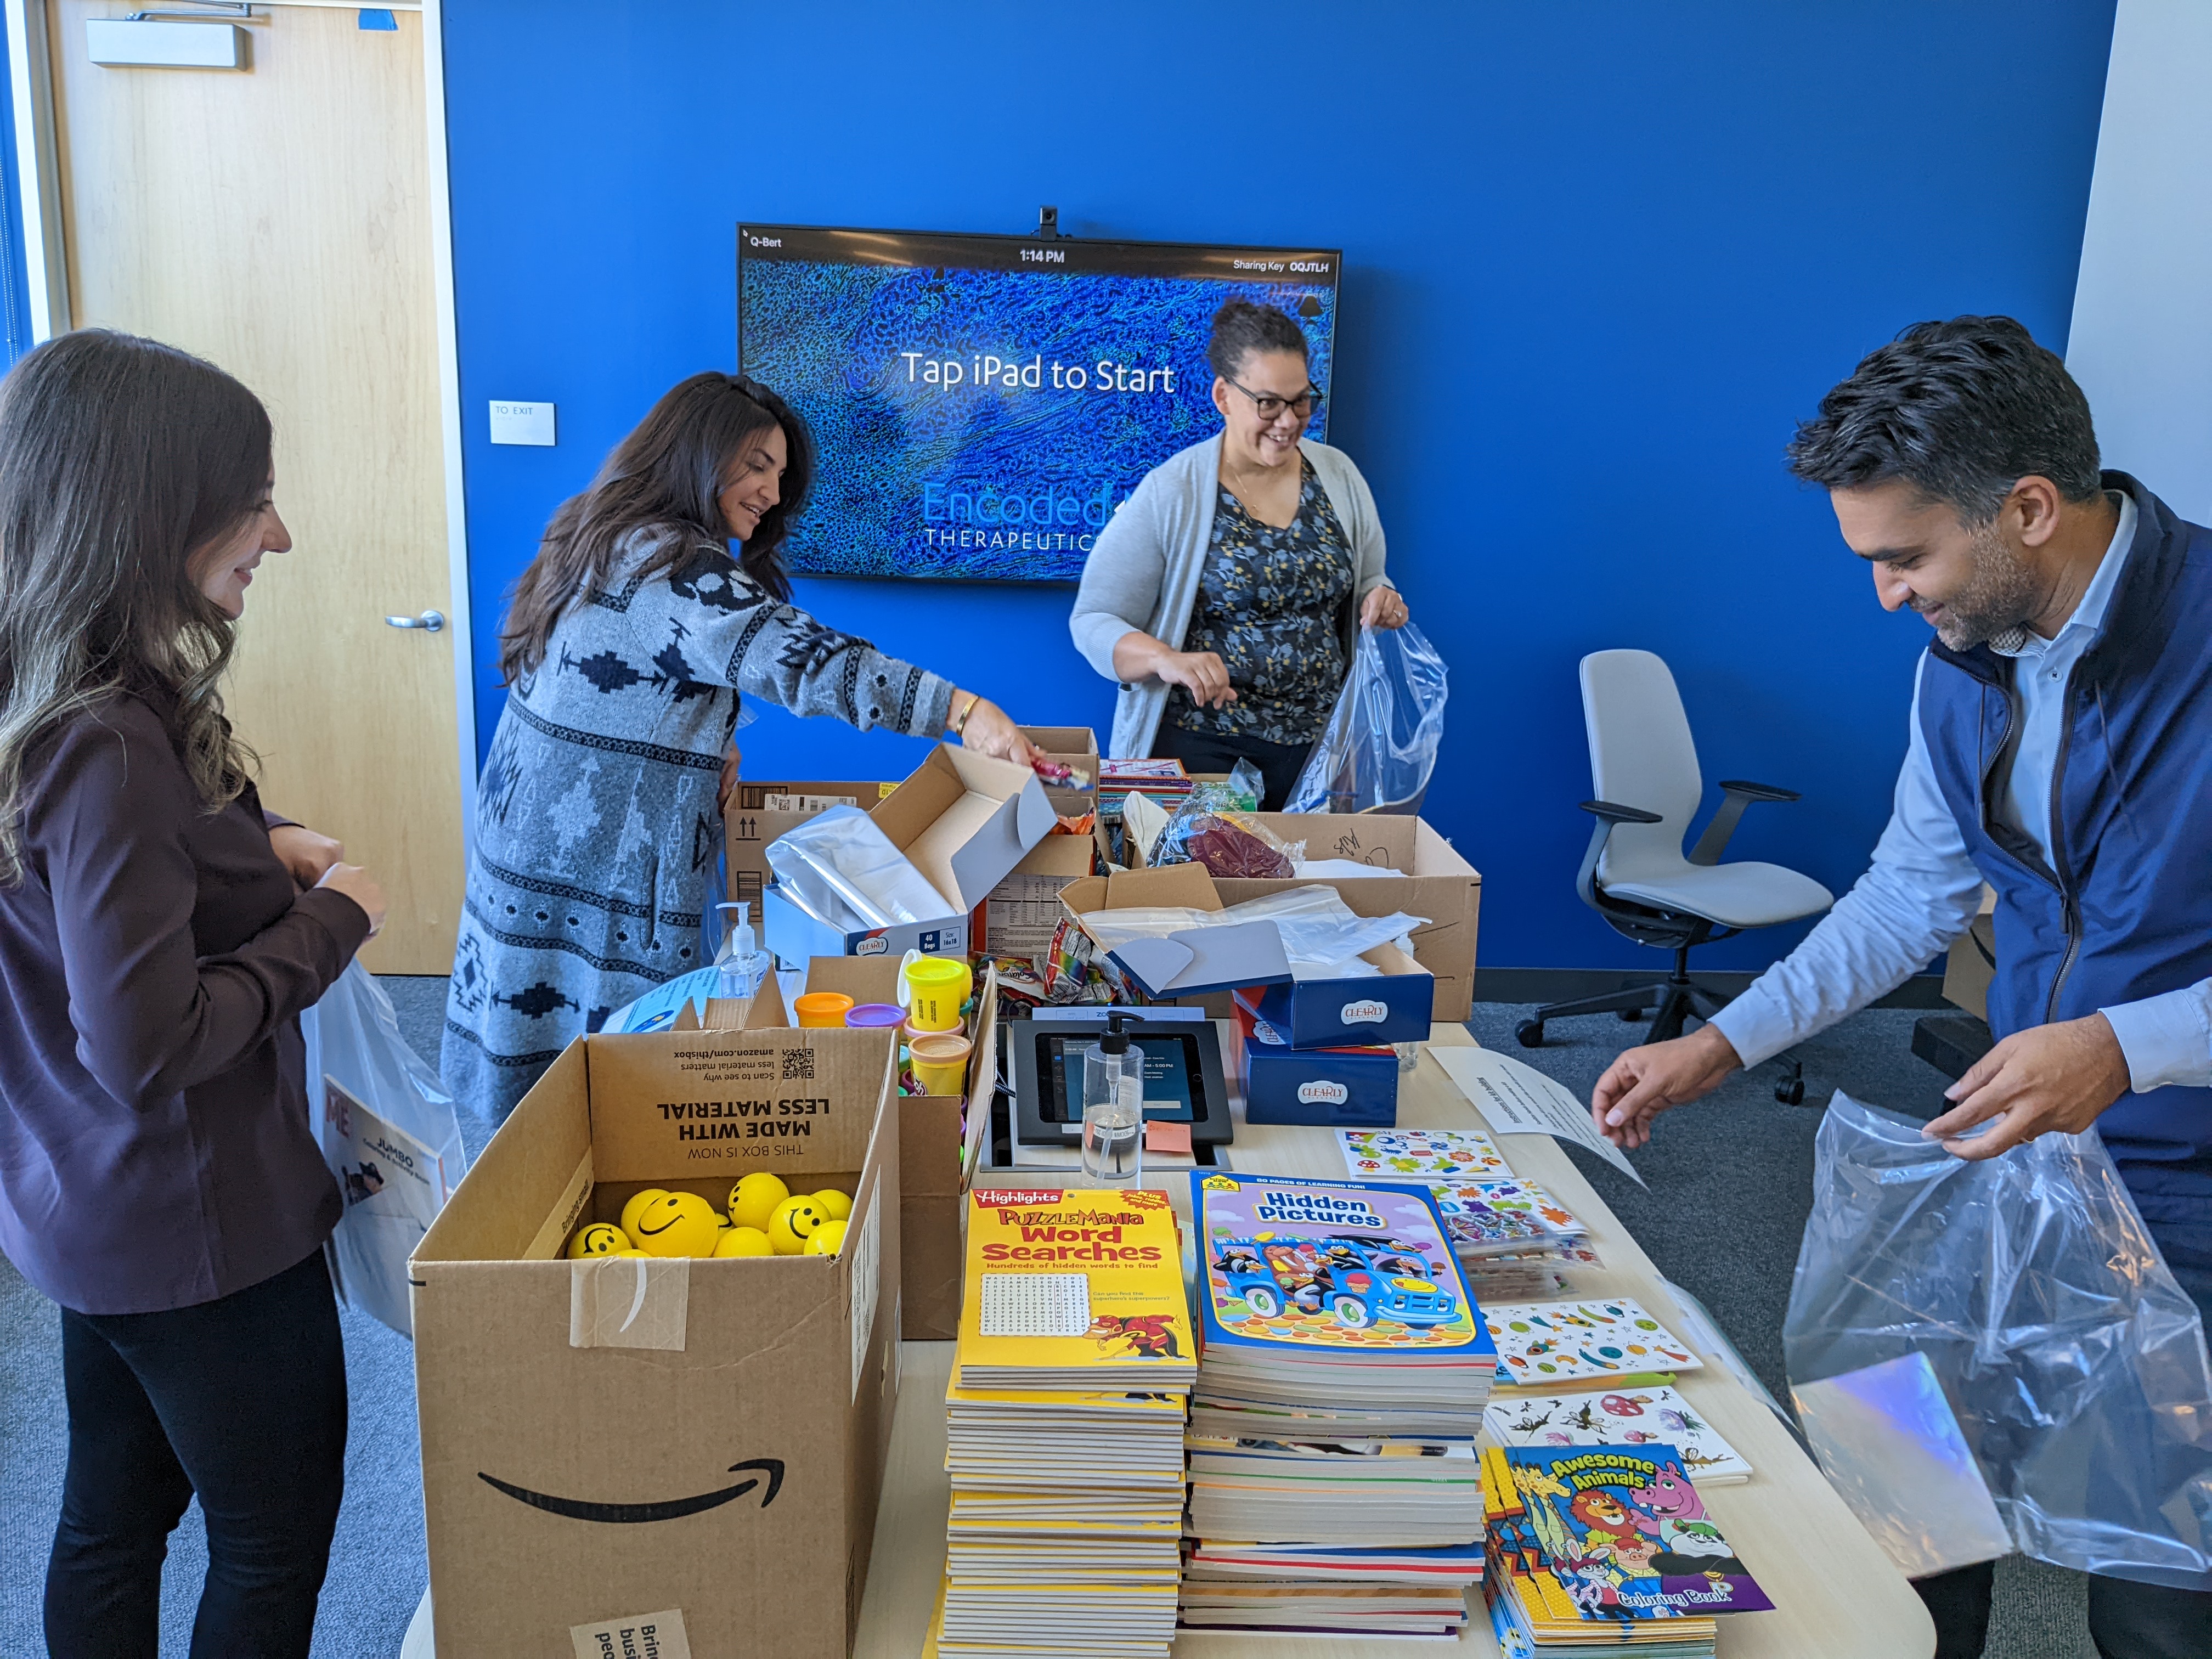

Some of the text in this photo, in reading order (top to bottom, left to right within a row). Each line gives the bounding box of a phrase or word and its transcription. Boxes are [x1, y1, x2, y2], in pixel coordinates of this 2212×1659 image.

[750, 236, 782, 247] Q-Bert
[1020, 249, 1064, 263] 1:14 PM
[1233, 260, 1329, 273] Sharing Key OQJTLH
[901, 352, 1175, 393] Tap iPad to Start
[924, 482, 1108, 526] Encoded
[924, 529, 1100, 551] THERAPEUTIC
[859, 940, 884, 951] CLEARLY
[925, 934, 933, 942] 40
[1345, 1005, 1384, 1017] CLEARLY
[674, 1049, 774, 1059] amazon.com/thisbox
[681, 1062, 716, 1070] matters
[718, 1062, 755, 1070] material
[703, 1073, 723, 1082] why
[1302, 1086, 1344, 1098] CLEARLY
[657, 1098, 830, 1120] LESS MATERIAL
[679, 1120, 811, 1141] MADE WITH
[377, 1137, 414, 1168] JUMBO
[688, 1144, 804, 1159] THIS BOX IS NOW
[976, 1191, 1059, 1205] Highlights
[1137, 1190, 1162, 1199] PLUS
[1265, 1192, 1367, 1212] Hidden
[1257, 1206, 1381, 1227] Pictures
[1021, 1226, 1122, 1243] Word
[981, 1242, 1162, 1261] Searches
[1550, 1453, 1655, 1478] Awesome
[1571, 1470, 1646, 1491] Animals
[1617, 1588, 1733, 1609] Coloring Book
